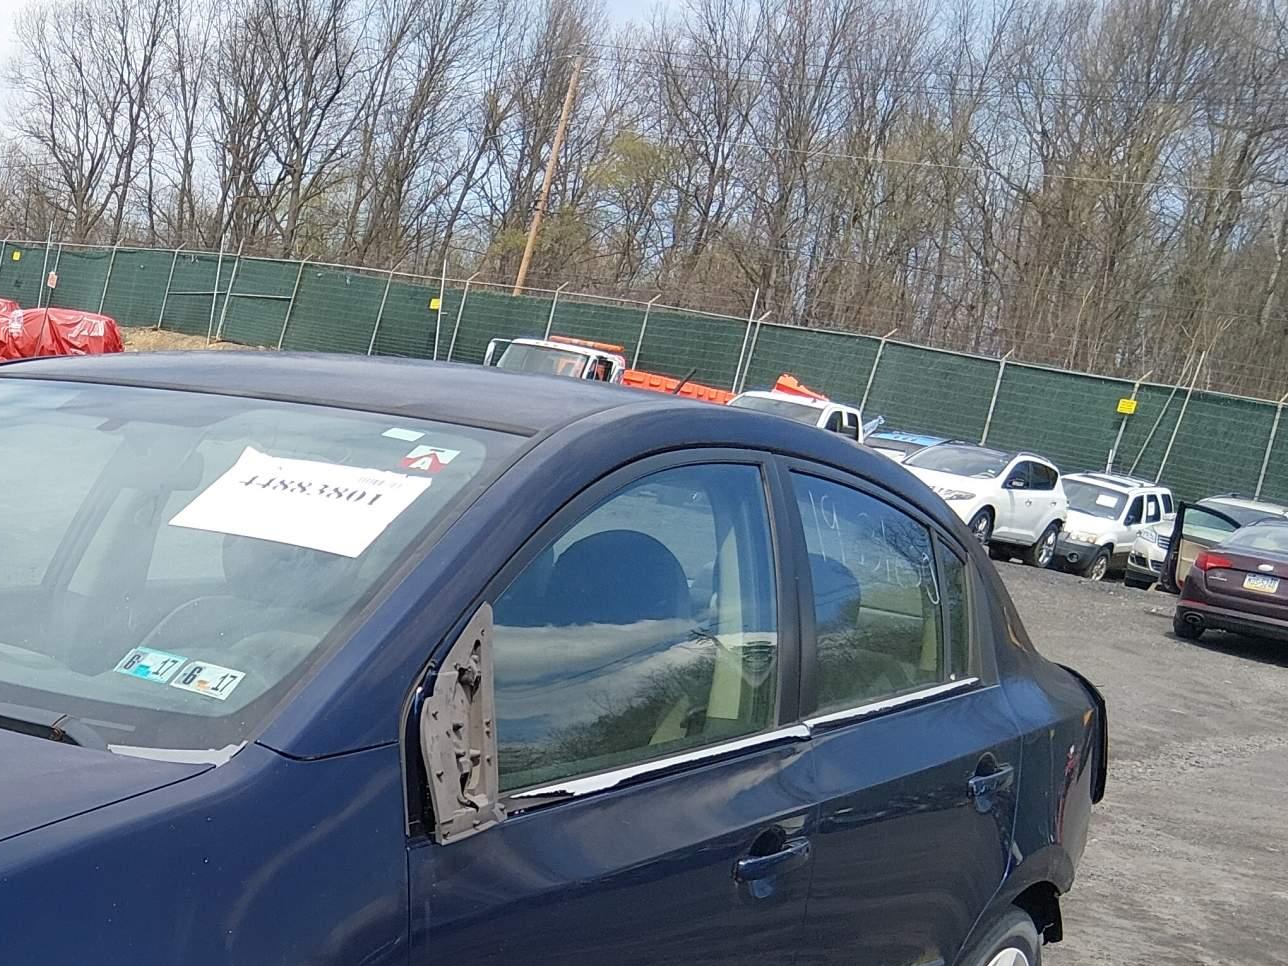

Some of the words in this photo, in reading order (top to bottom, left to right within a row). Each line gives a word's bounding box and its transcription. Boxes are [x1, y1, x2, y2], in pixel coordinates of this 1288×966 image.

[123, 654, 141, 670] 6
[151, 658, 179, 677] 17
[210, 673, 238, 693] 17
